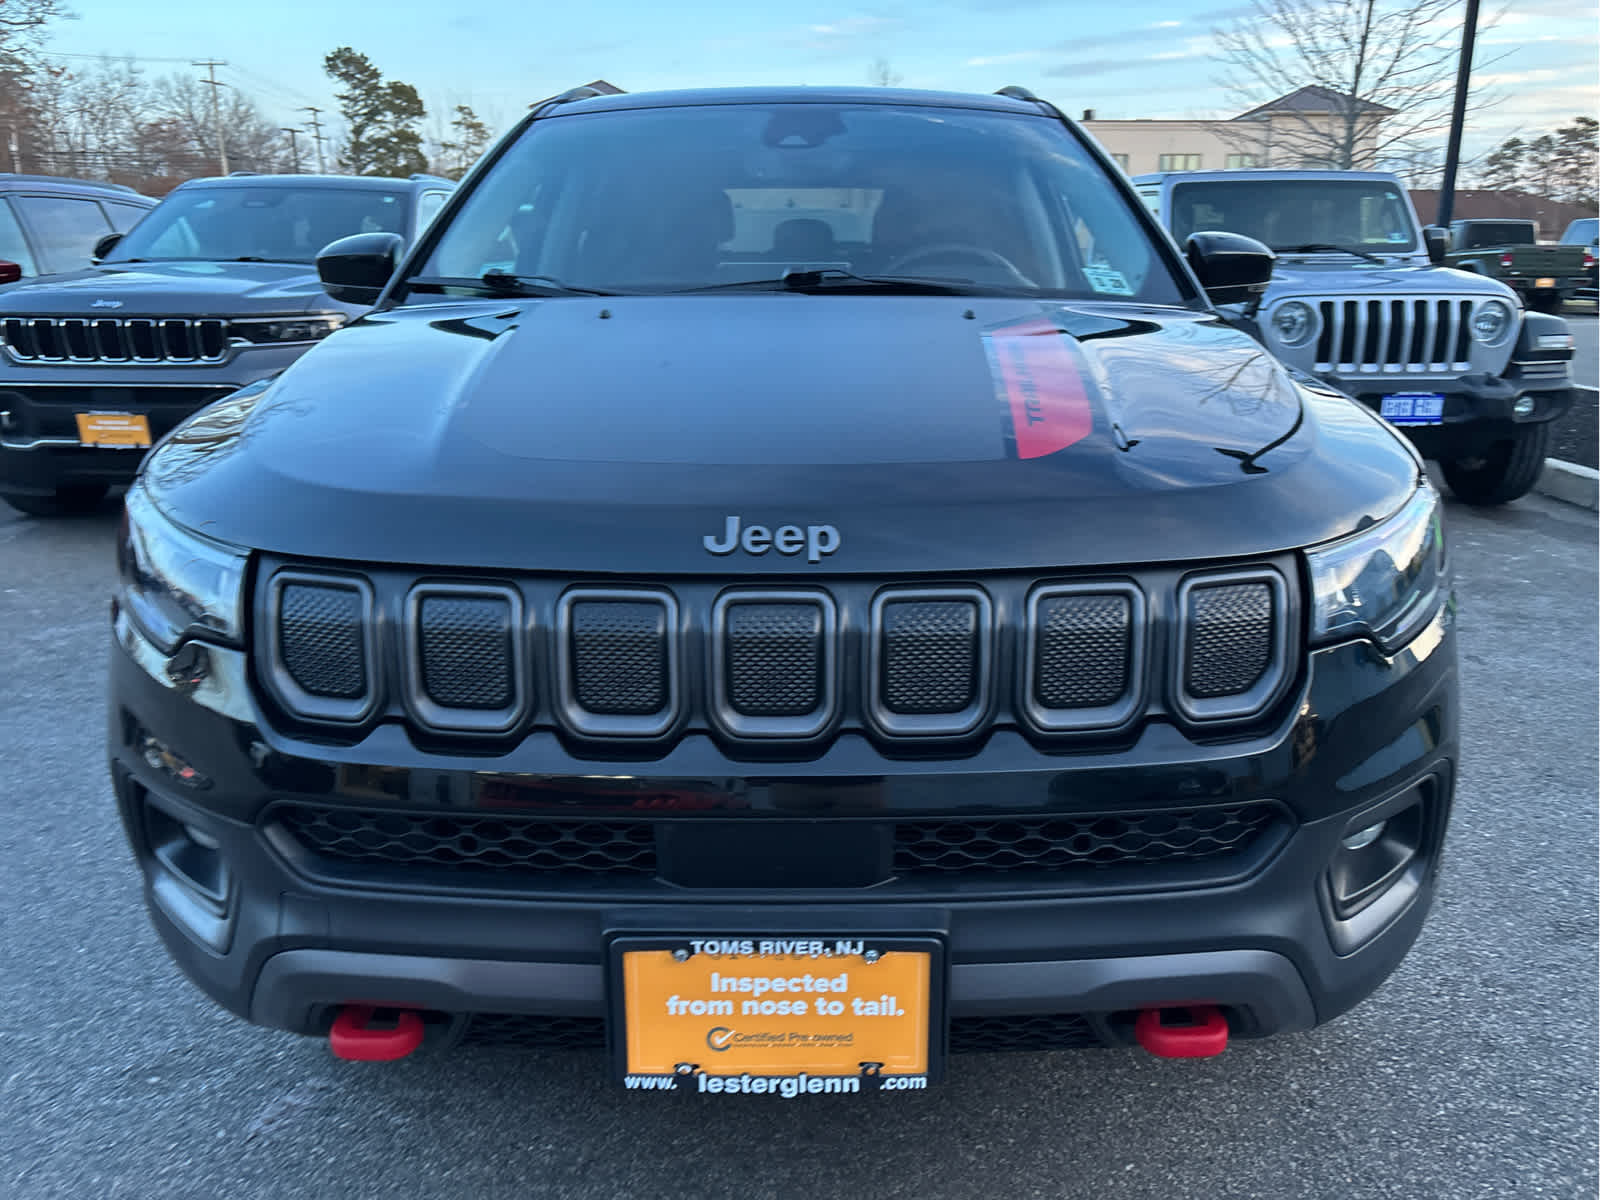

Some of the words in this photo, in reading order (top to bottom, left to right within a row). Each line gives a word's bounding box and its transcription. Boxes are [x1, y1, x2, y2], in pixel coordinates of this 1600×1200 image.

[703, 515, 841, 562] Jeep
[689, 940, 754, 955] TOMS
[835, 940, 865, 955] NJ
[710, 972, 849, 997] Inspected
[665, 994, 734, 1016] from
[741, 999, 809, 1016] nose
[814, 997, 846, 1016] to
[851, 994, 905, 1016] tail.
[624, 1075, 678, 1090] www.
[698, 1073, 861, 1099] lesterglenn
[879, 1075, 928, 1091] .com
